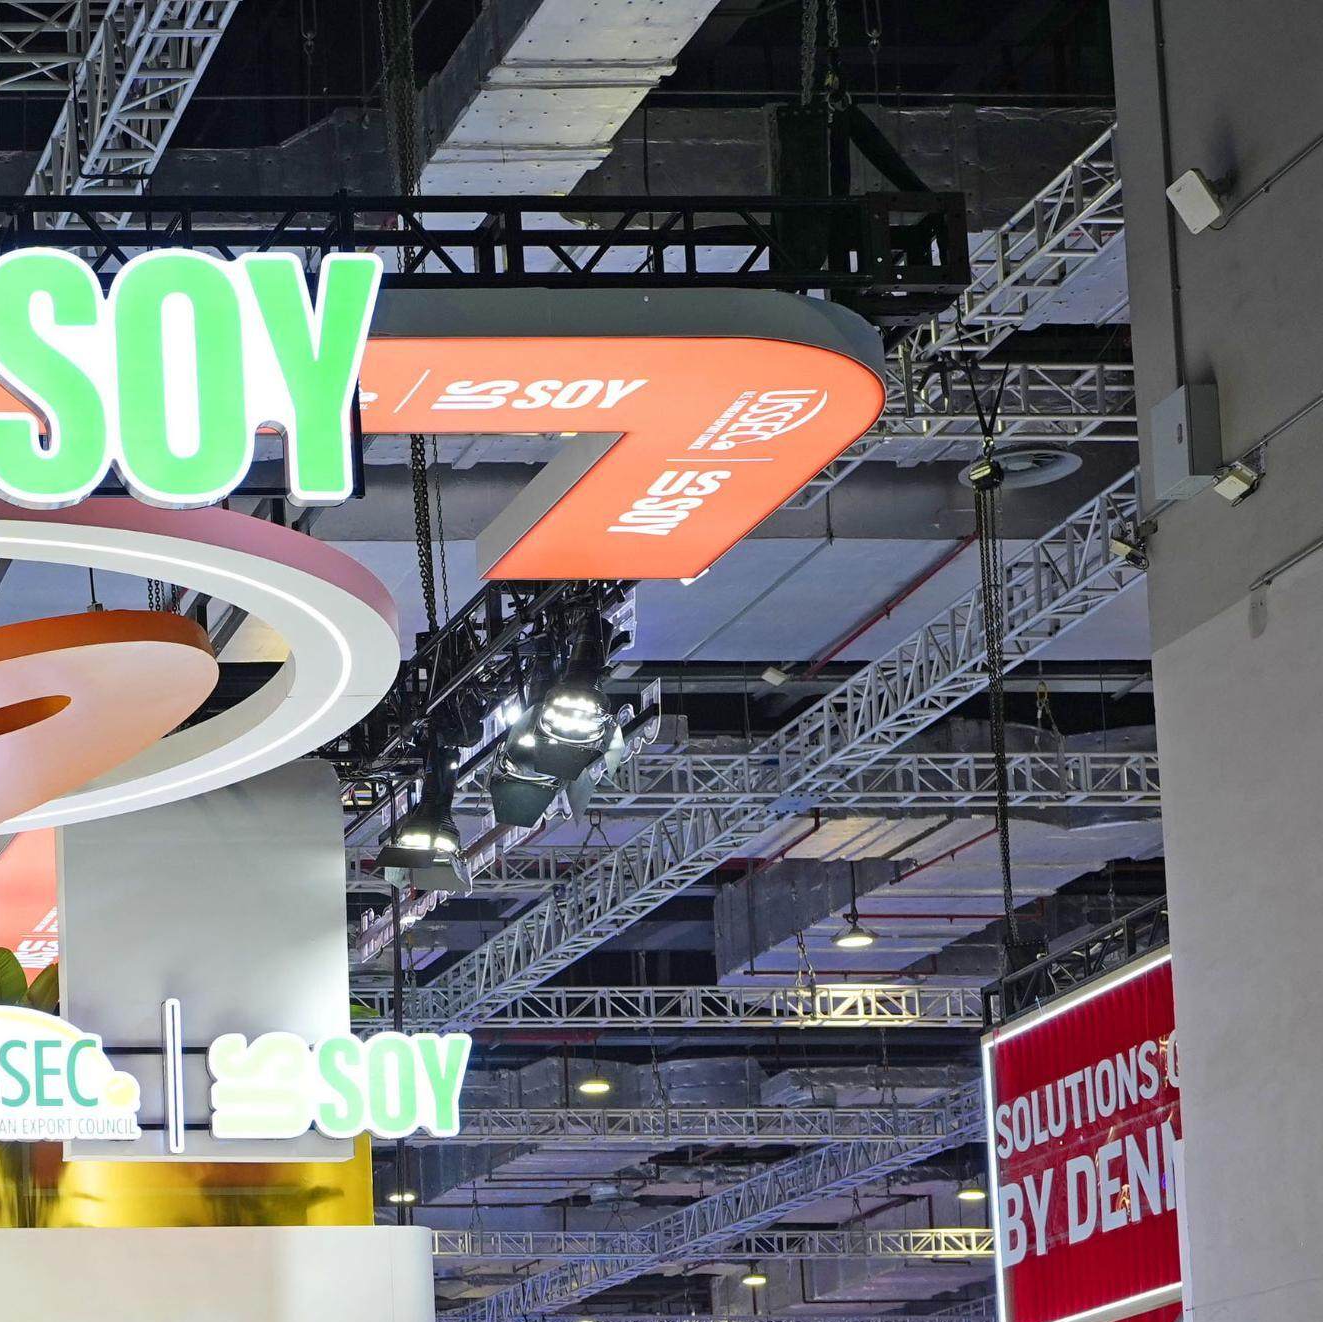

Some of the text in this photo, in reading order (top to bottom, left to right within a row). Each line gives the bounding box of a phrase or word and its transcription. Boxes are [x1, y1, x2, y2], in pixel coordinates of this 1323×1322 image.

[513, 379, 650, 409] SOY
[22, 1116, 73, 1136] EXPORT
[77, 1116, 137, 1136] COUNCIL
[318, 1037, 465, 1132] SOY
[994, 1039, 1160, 1161] SOLUTIONS
[999, 1166, 1054, 1269] BY
